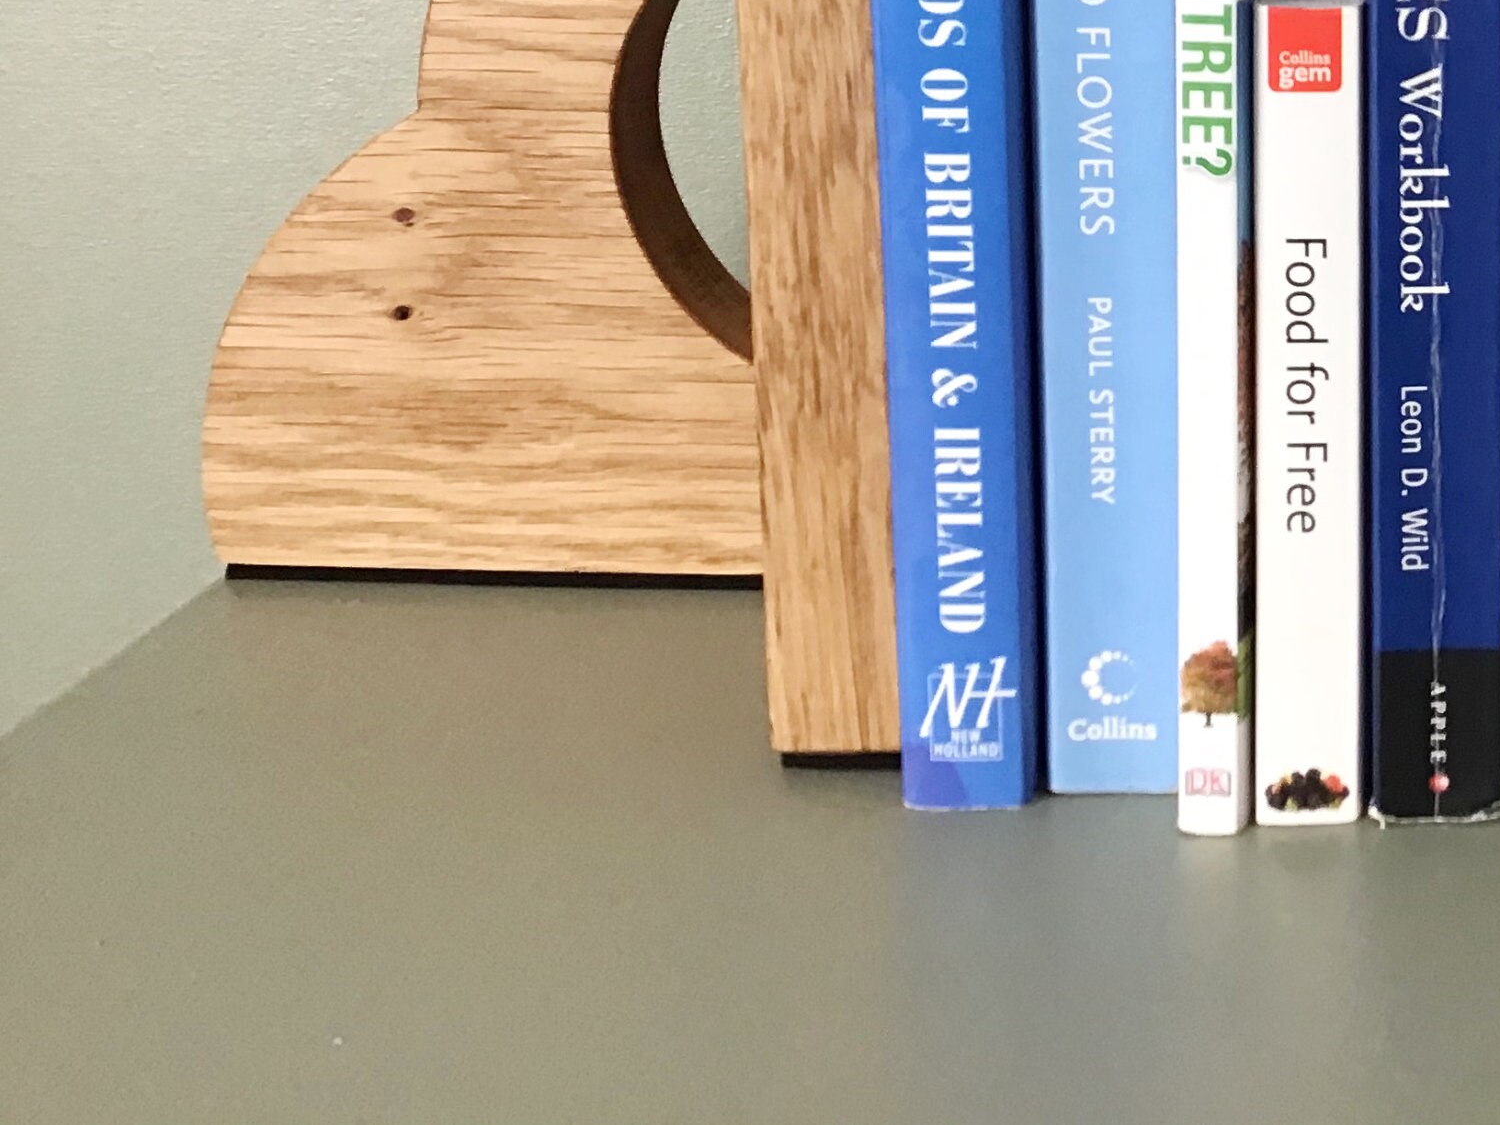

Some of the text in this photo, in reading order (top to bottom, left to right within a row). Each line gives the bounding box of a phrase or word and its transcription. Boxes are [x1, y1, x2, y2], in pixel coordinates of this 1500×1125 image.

[1181, 4, 1234, 177] TREE?
[1278, 64, 1332, 89] gem
[1279, 51, 1332, 65] Collins
[920, 68, 971, 134] OF
[1076, 27, 1115, 236] FLOWERS
[1399, 62, 1452, 313] Workbook
[923, 152, 978, 350] BRITAIN
[931, 368, 979, 408] &
[1087, 297, 1116, 506] PAUL STERRY
[1285, 238, 1329, 533] Food for Free
[1400, 386, 1430, 572] Leon D. Wild
[933, 427, 987, 634] IRELAND
[933, 742, 999, 758] HOLLAND
[951, 728, 981, 743] NEW
[1067, 716, 1158, 741] Collins
[1430, 681, 1447, 764] APPLE
[1189, 770, 1227, 794] DK
